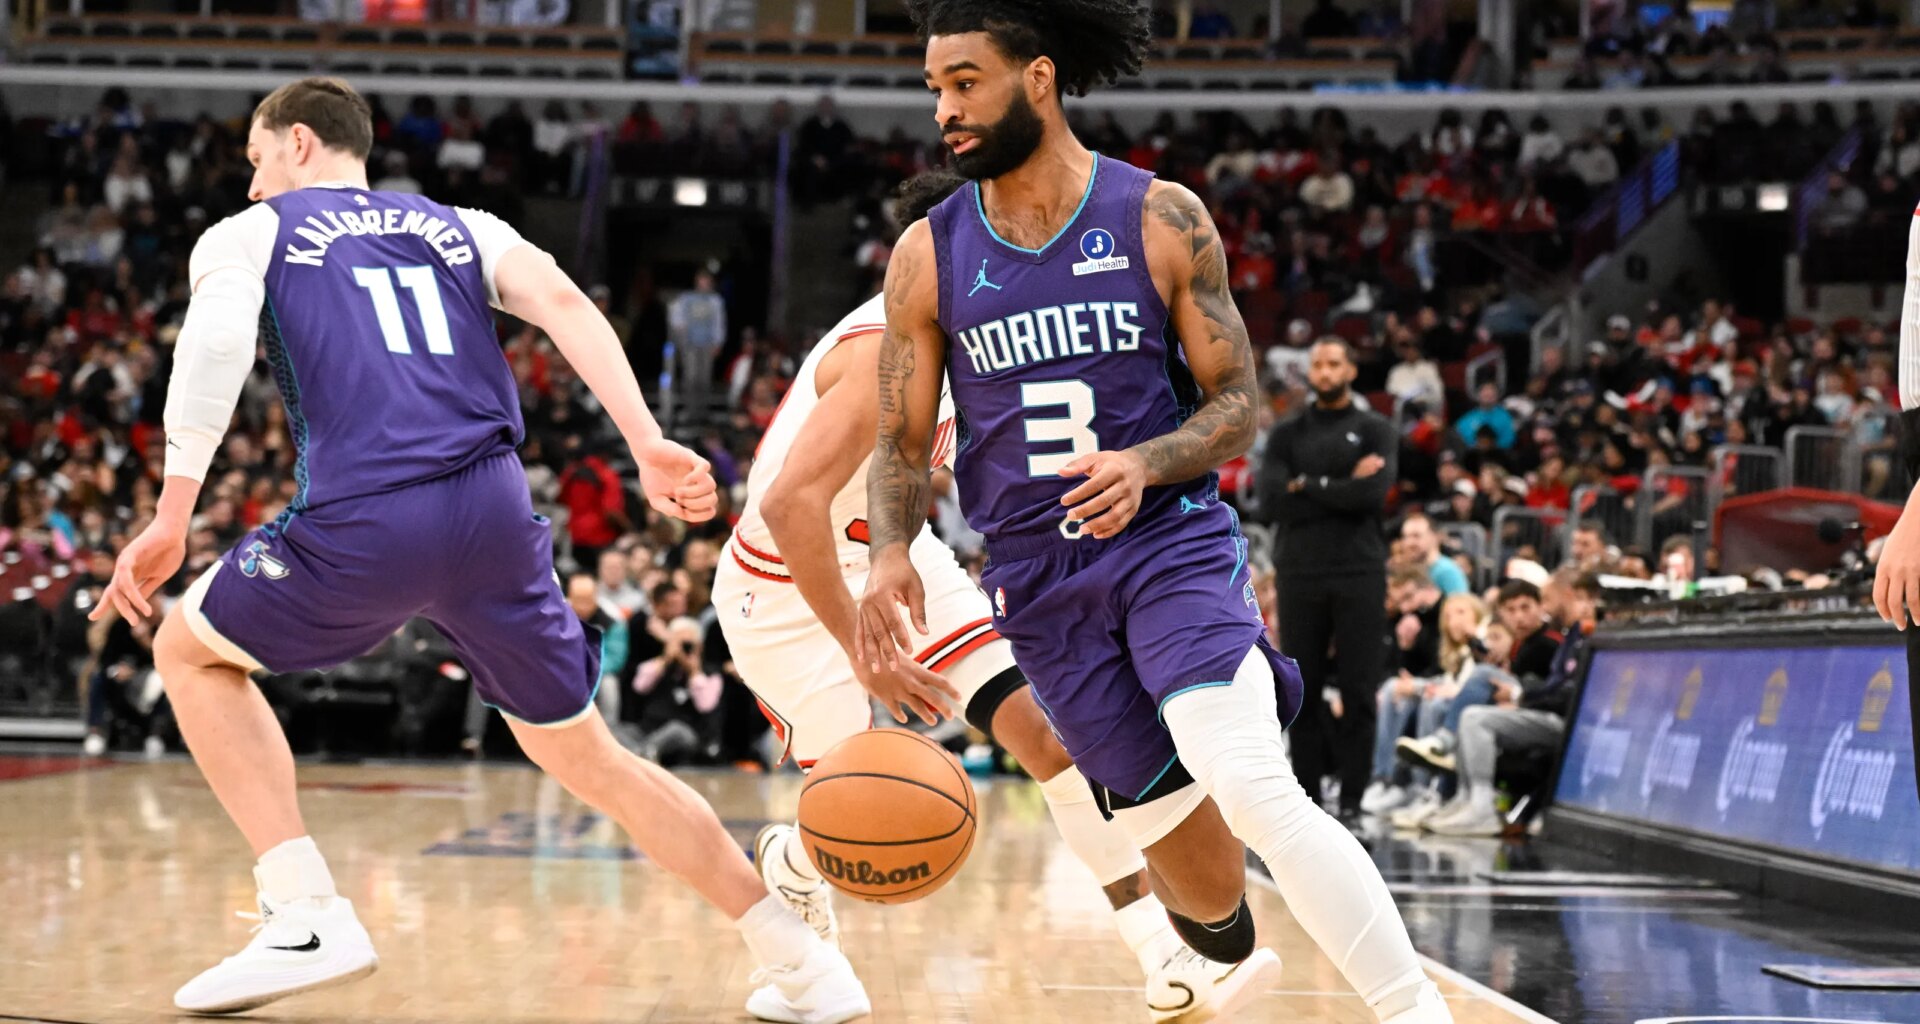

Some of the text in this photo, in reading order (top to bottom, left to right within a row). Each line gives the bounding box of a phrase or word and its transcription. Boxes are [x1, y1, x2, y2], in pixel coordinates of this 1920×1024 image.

[352, 264, 455, 356] 11
[958, 302, 1146, 374] HORNETS
[1021, 379, 1100, 478] 3
[814, 843, 932, 886] Wilson
